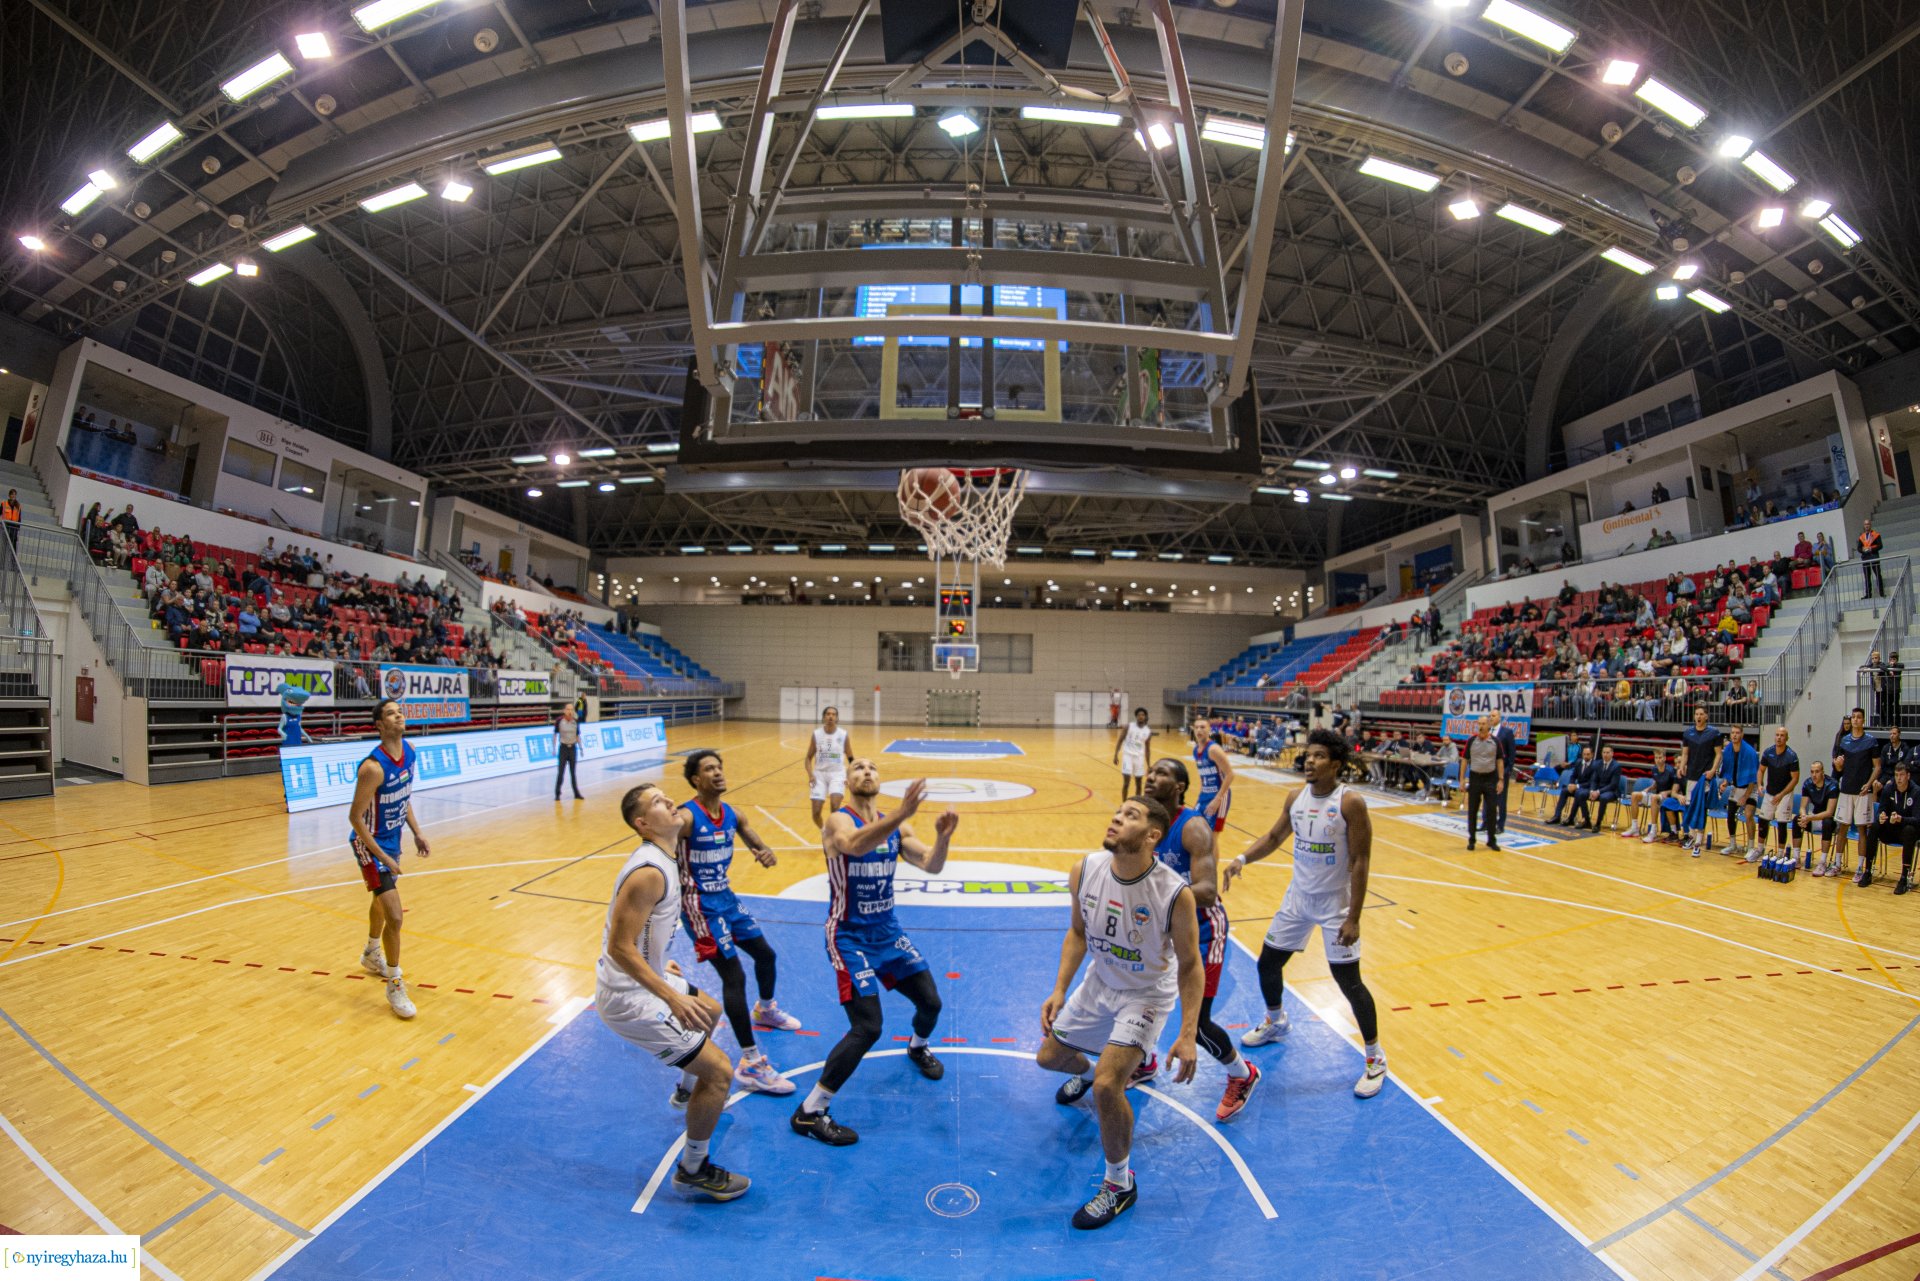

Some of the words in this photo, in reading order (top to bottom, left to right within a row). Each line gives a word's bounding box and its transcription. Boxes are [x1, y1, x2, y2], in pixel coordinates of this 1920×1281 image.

[1603, 509, 1652, 535] Continental
[409, 672, 463, 695] HAJRÁ
[1469, 688, 1526, 713] HAJRÁ
[466, 743, 521, 766] HÜBNER
[877, 879, 887, 900] 7
[892, 879, 1070, 894] PPMIX
[1105, 915, 1118, 937] 8
[1127, 1018, 1146, 1029] ALAN
